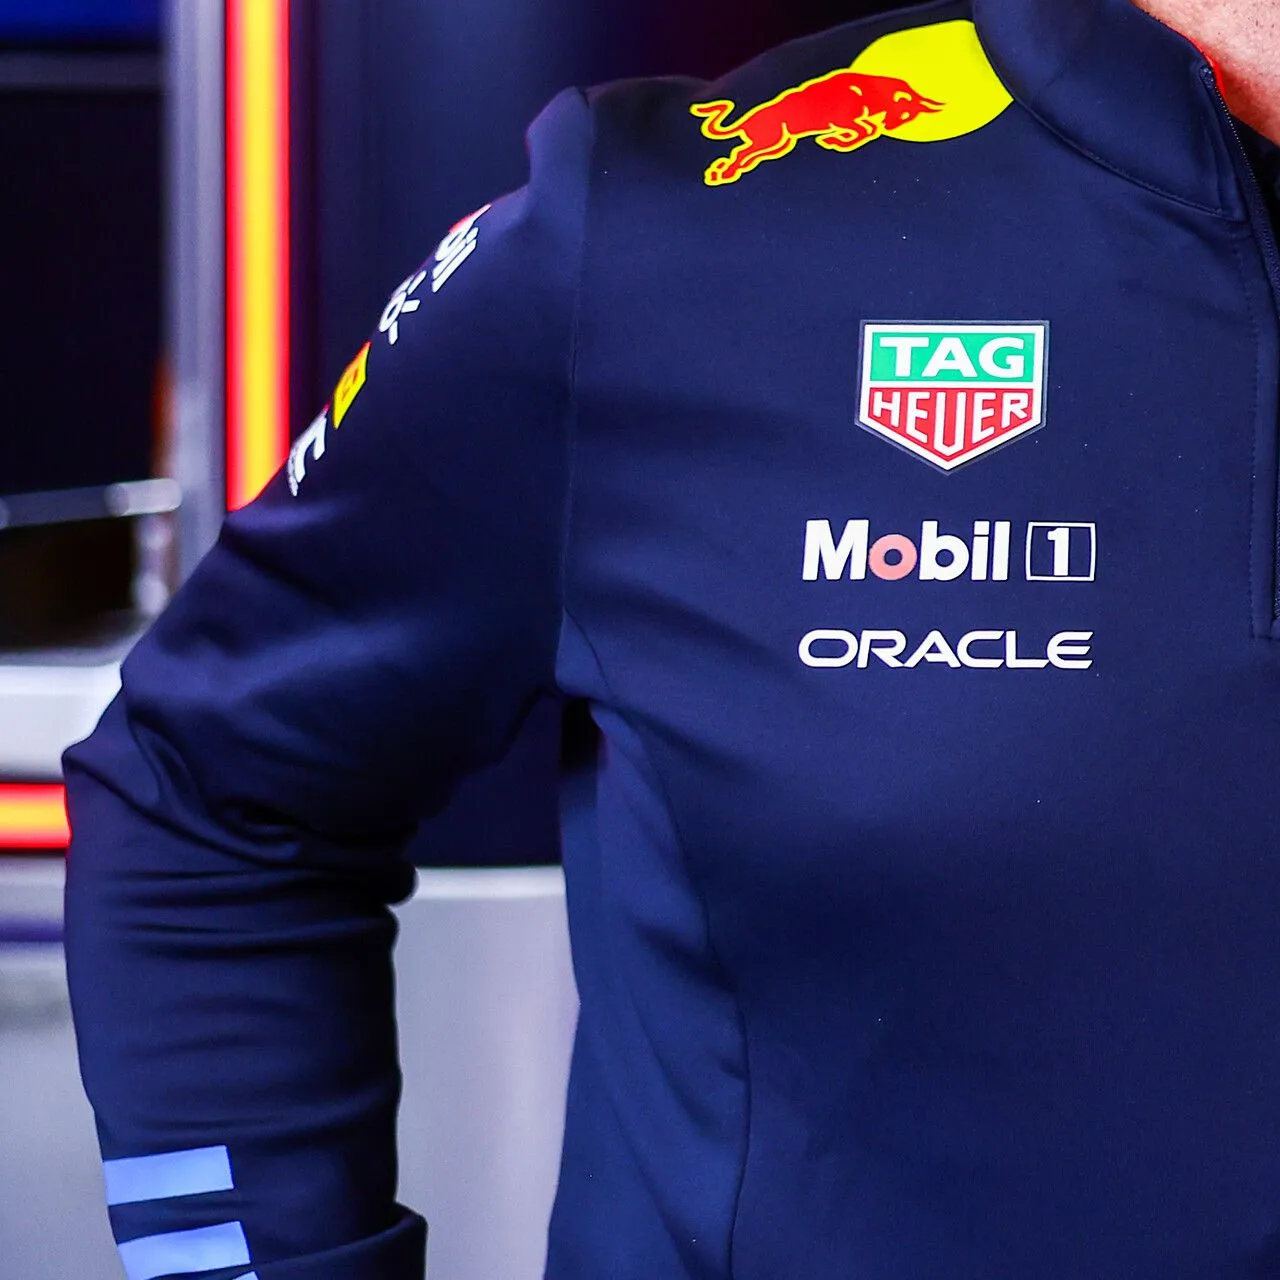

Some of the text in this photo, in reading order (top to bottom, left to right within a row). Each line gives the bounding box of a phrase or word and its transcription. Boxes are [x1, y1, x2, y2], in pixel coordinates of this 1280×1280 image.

[880, 336, 1026, 379] TAG
[872, 388, 1030, 453] HEUER
[802, 518, 1011, 582] Mobil
[798, 629, 1095, 670] ORACLE
